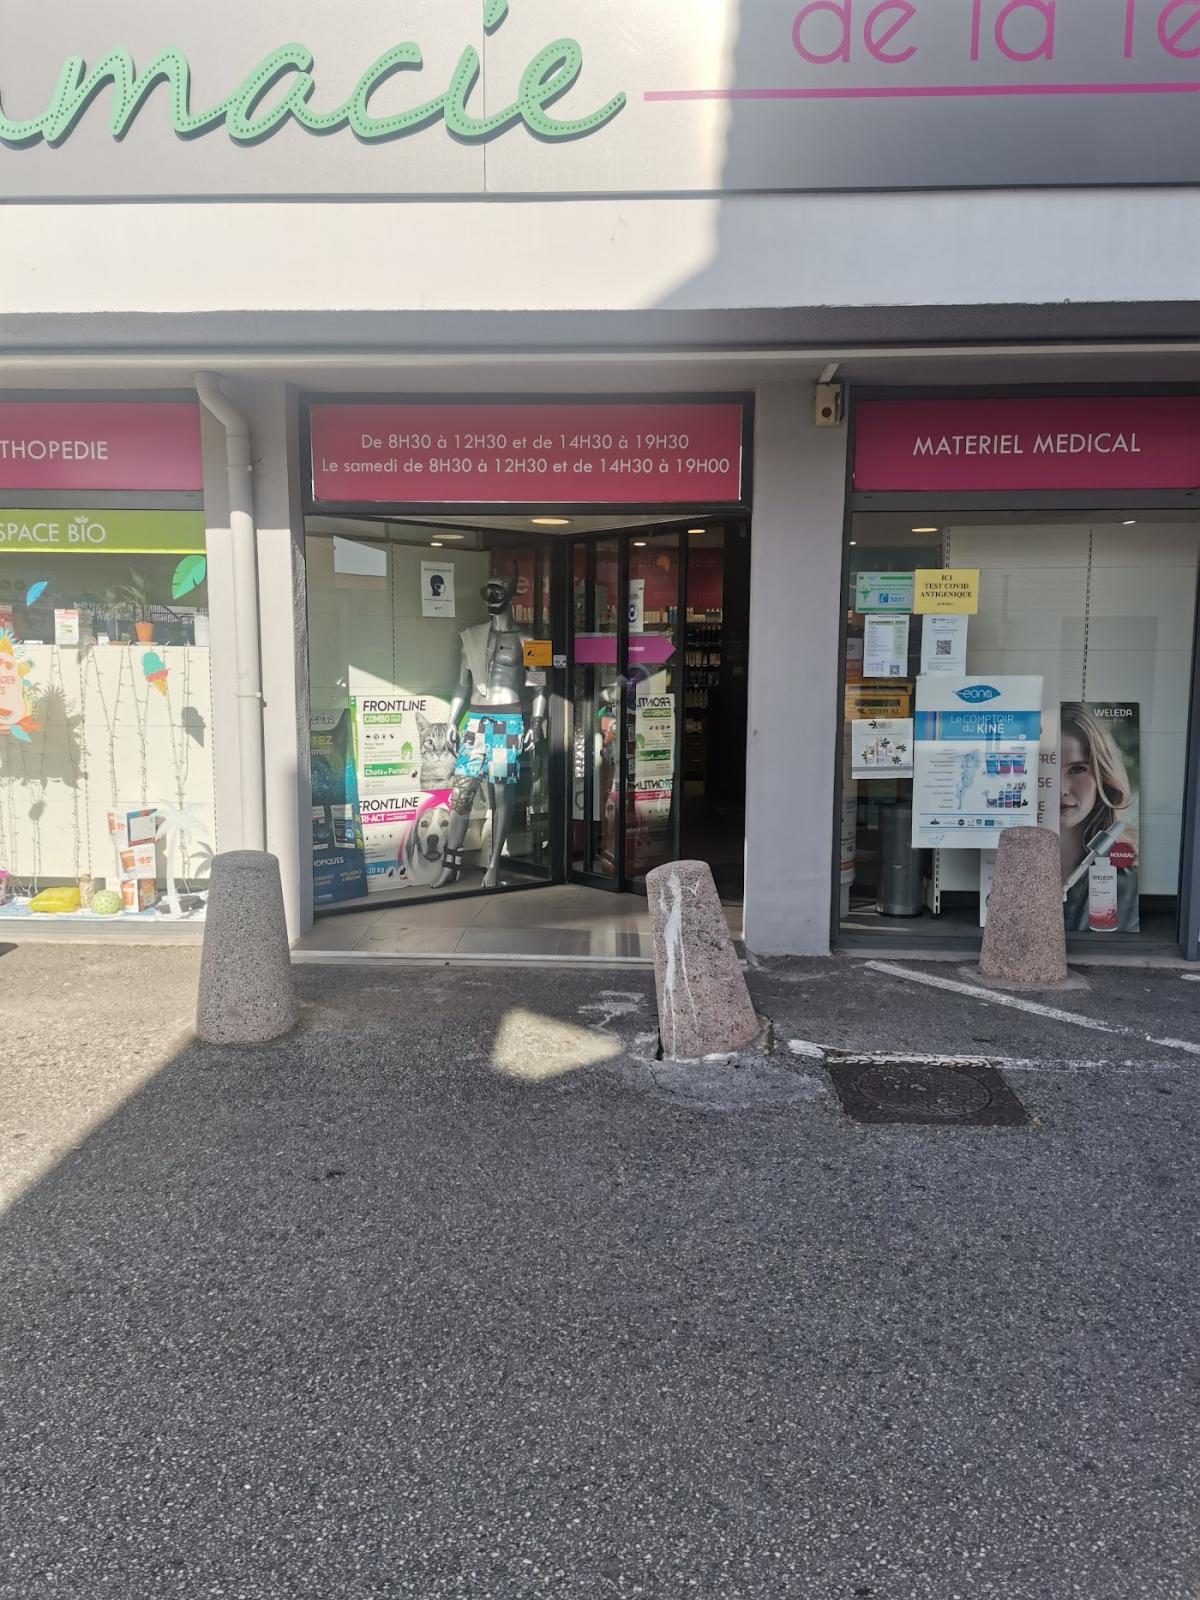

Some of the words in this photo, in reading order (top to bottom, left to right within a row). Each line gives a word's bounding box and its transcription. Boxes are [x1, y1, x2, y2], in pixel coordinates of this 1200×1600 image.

[792, 0, 918, 65] de
[970, 0, 1056, 62] la
[361, 434, 384, 449] De
[388, 434, 431, 449] 8H30
[438, 433, 448, 449] à
[453, 434, 507, 449] 12H30
[512, 434, 528, 449] et
[532, 434, 553, 449] de
[559, 434, 613, 449] 14H30
[618, 433, 628, 449] à
[635, 434, 689, 449] 19H30
[913, 435, 1024, 456] MATERIEL
[1032, 433, 1141, 454] MEDICAL
[322, 458, 339, 474] Le
[343, 458, 398, 474] samedi
[403, 458, 423, 474] de
[428, 458, 472, 474] 8H30
[478, 458, 488, 474] à
[494, 458, 548, 474] 12H30
[552, 458, 569, 474] et
[573, 458, 593, 474] de
[600, 458, 653, 474] 14H30
[659, 458, 669, 474] à
[676, 458, 730, 474] 19H00
[363, 700, 427, 712] FRONTLINE
[1094, 708, 1133, 717] WELEDA
[963, 714, 1014, 724] COMPTOIR
[359, 796, 420, 812] FRONTLINE
